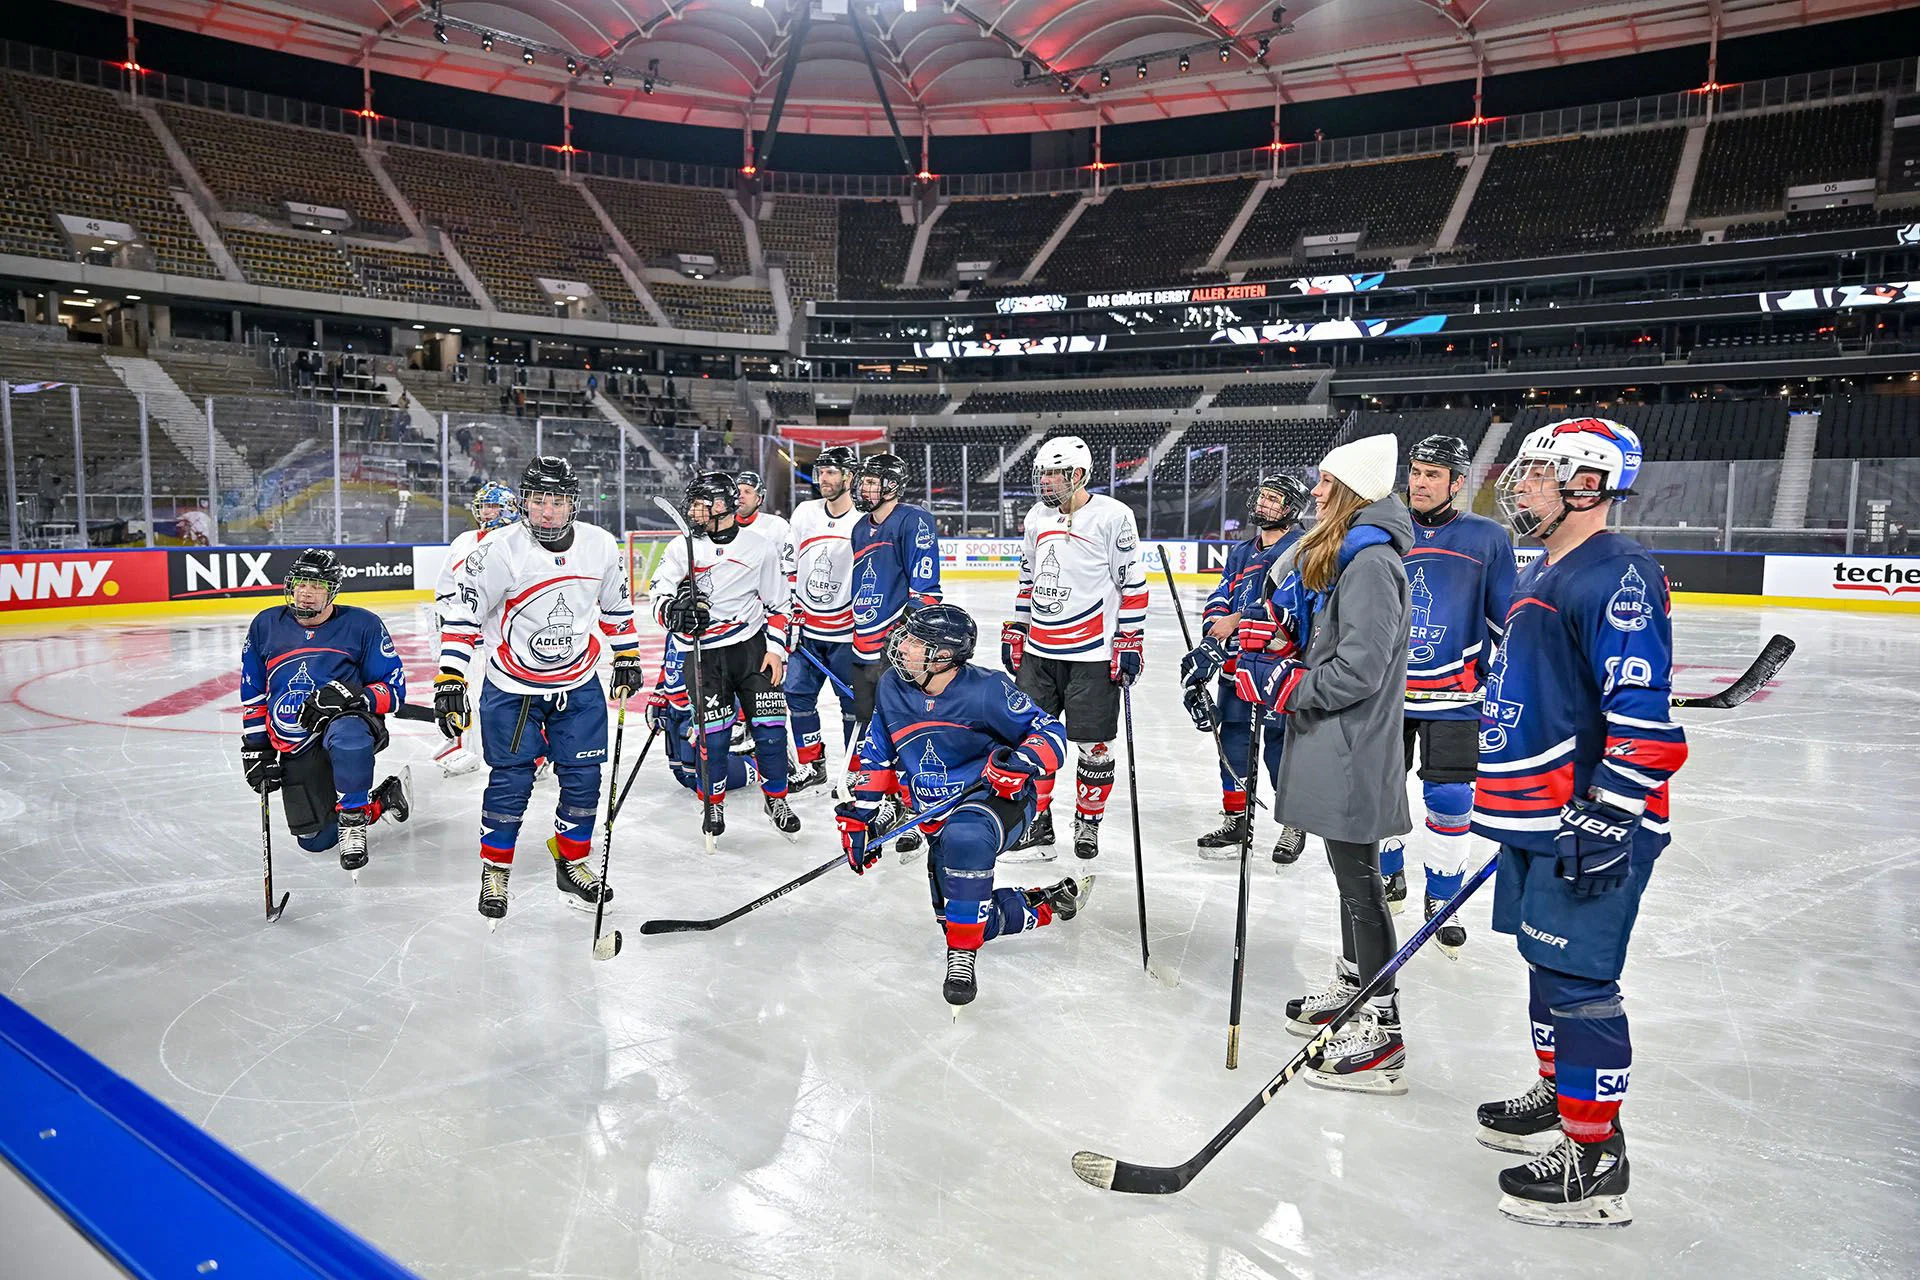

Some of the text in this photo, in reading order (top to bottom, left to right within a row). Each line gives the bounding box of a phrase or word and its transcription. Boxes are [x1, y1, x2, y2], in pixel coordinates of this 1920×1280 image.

[1824, 184, 1837, 192] 05
[306, 206, 317, 214] 47
[85, 221, 100, 232] 45
[1087, 294, 1110, 308] DAS
[1154, 289, 1191, 304] DERBY
[1191, 287, 1225, 302] ALLER
[1226, 284, 1266, 299] ZEITEN
[185, 552, 273, 592] NIX
[809, 579, 830, 590] ADLER
[1033, 586, 1058, 598] ADLER
[535, 636, 573, 647] ADLER
[576, 748, 606, 759] CCM
[916, 787, 949, 797] ADLER
[1079, 783, 1102, 801] 92
[1261, 1024, 1334, 1105] CCM
